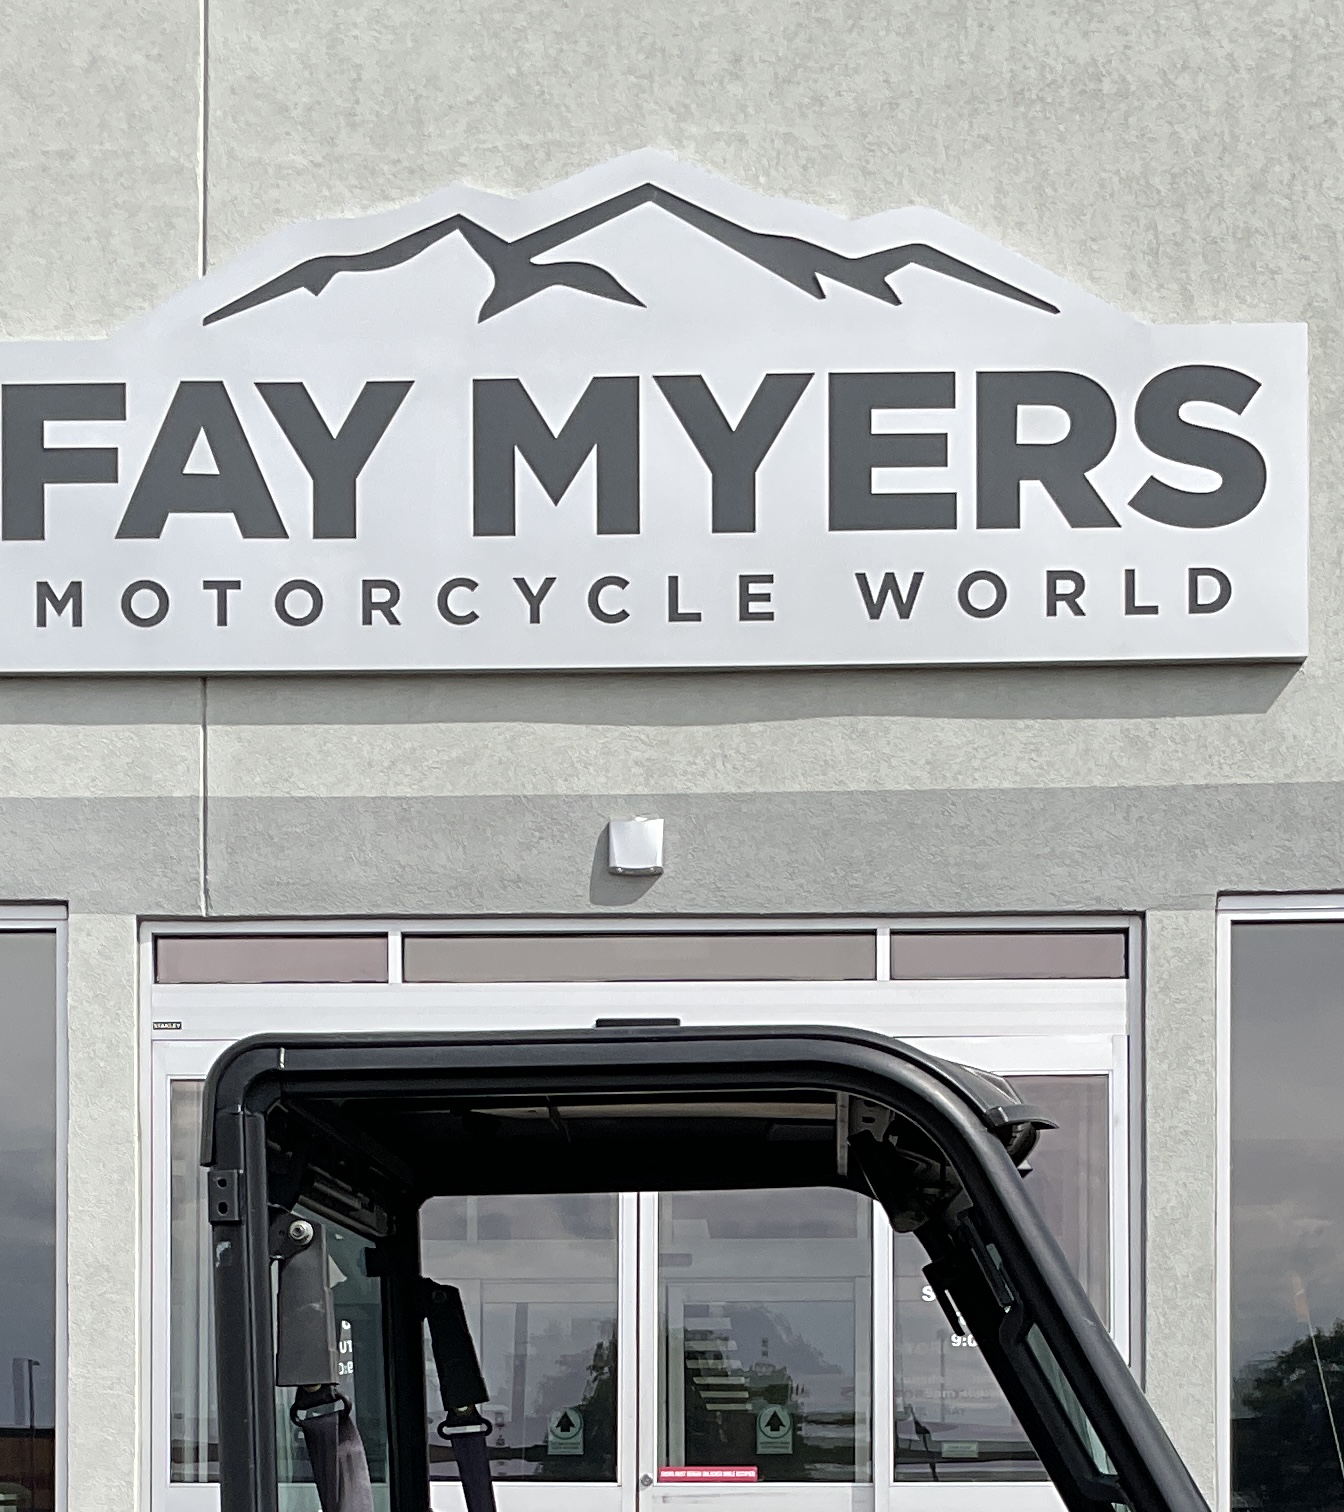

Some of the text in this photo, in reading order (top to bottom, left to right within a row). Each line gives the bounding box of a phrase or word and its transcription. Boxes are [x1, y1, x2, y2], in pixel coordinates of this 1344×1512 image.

[1, 364, 1268, 541] FAY MYERS
[37, 568, 1234, 628] MOTORCYCLE WORLD
